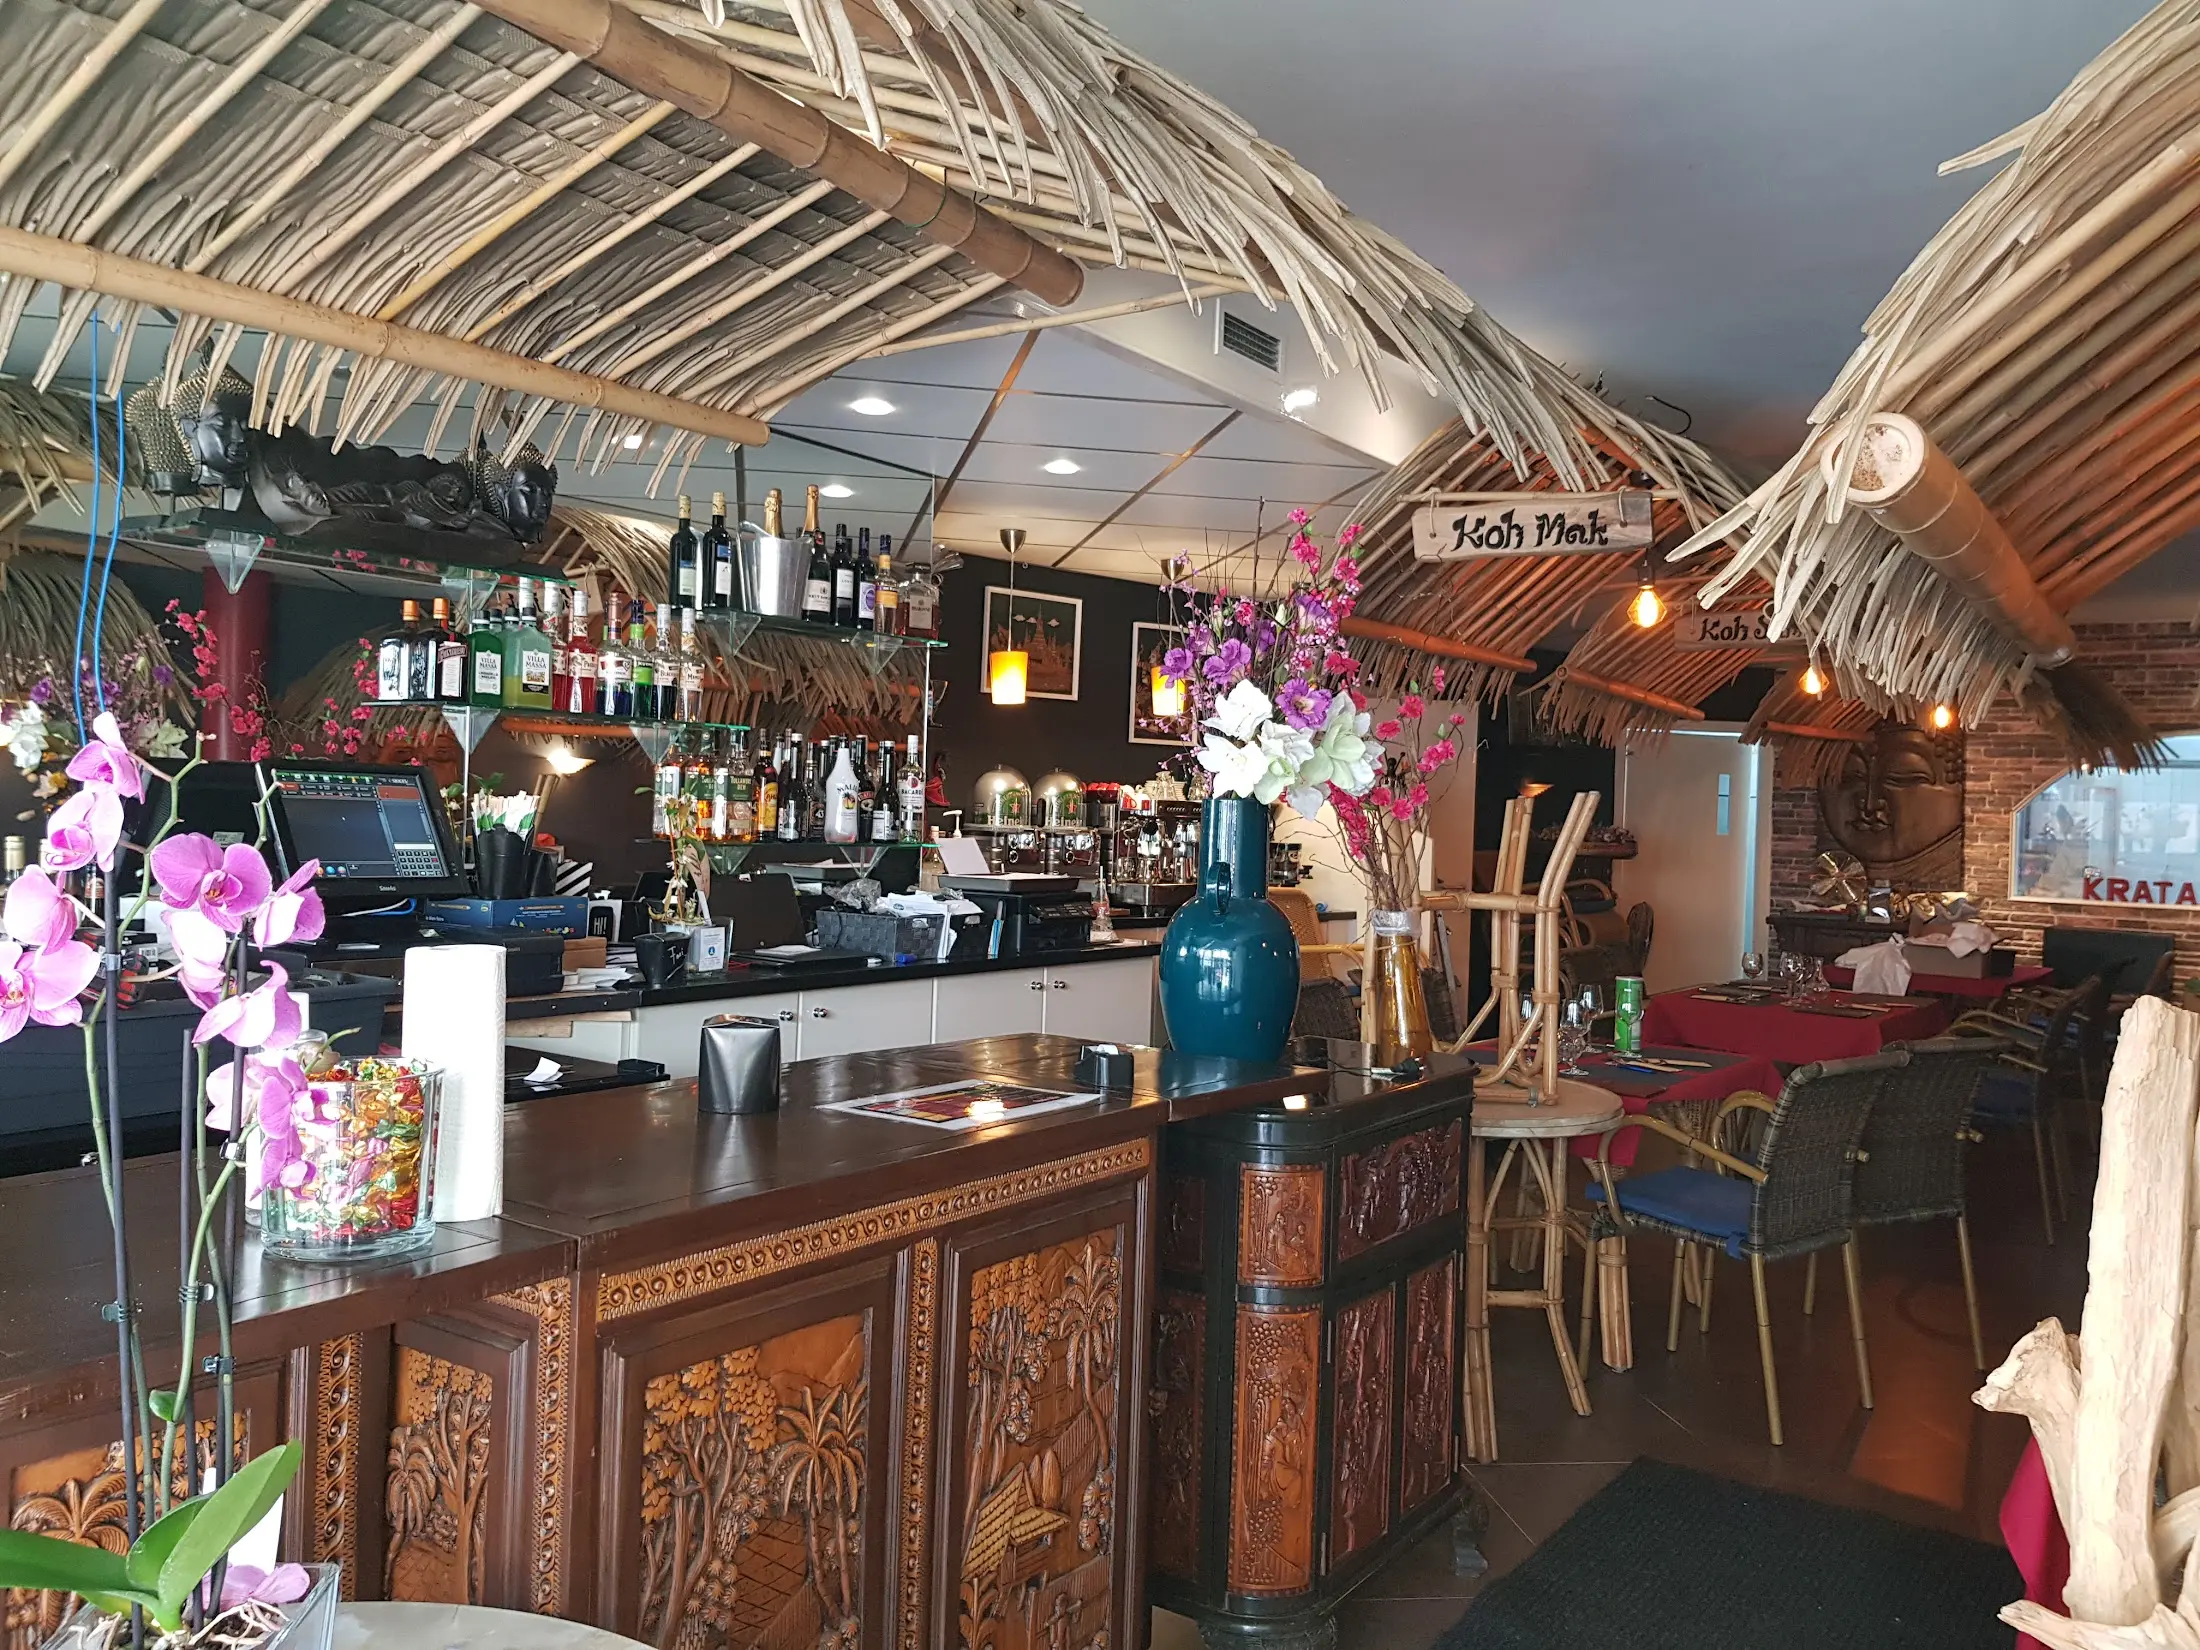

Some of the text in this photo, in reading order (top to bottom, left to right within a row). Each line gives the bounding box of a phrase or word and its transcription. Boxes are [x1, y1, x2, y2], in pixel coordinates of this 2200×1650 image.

[1451, 508, 1609, 552] Koh Mak
[1698, 615, 1748, 641] Koh
[526, 661, 546, 669] MASSA
[527, 655, 545, 663] VILLA
[2082, 877, 2197, 905] KRATA
